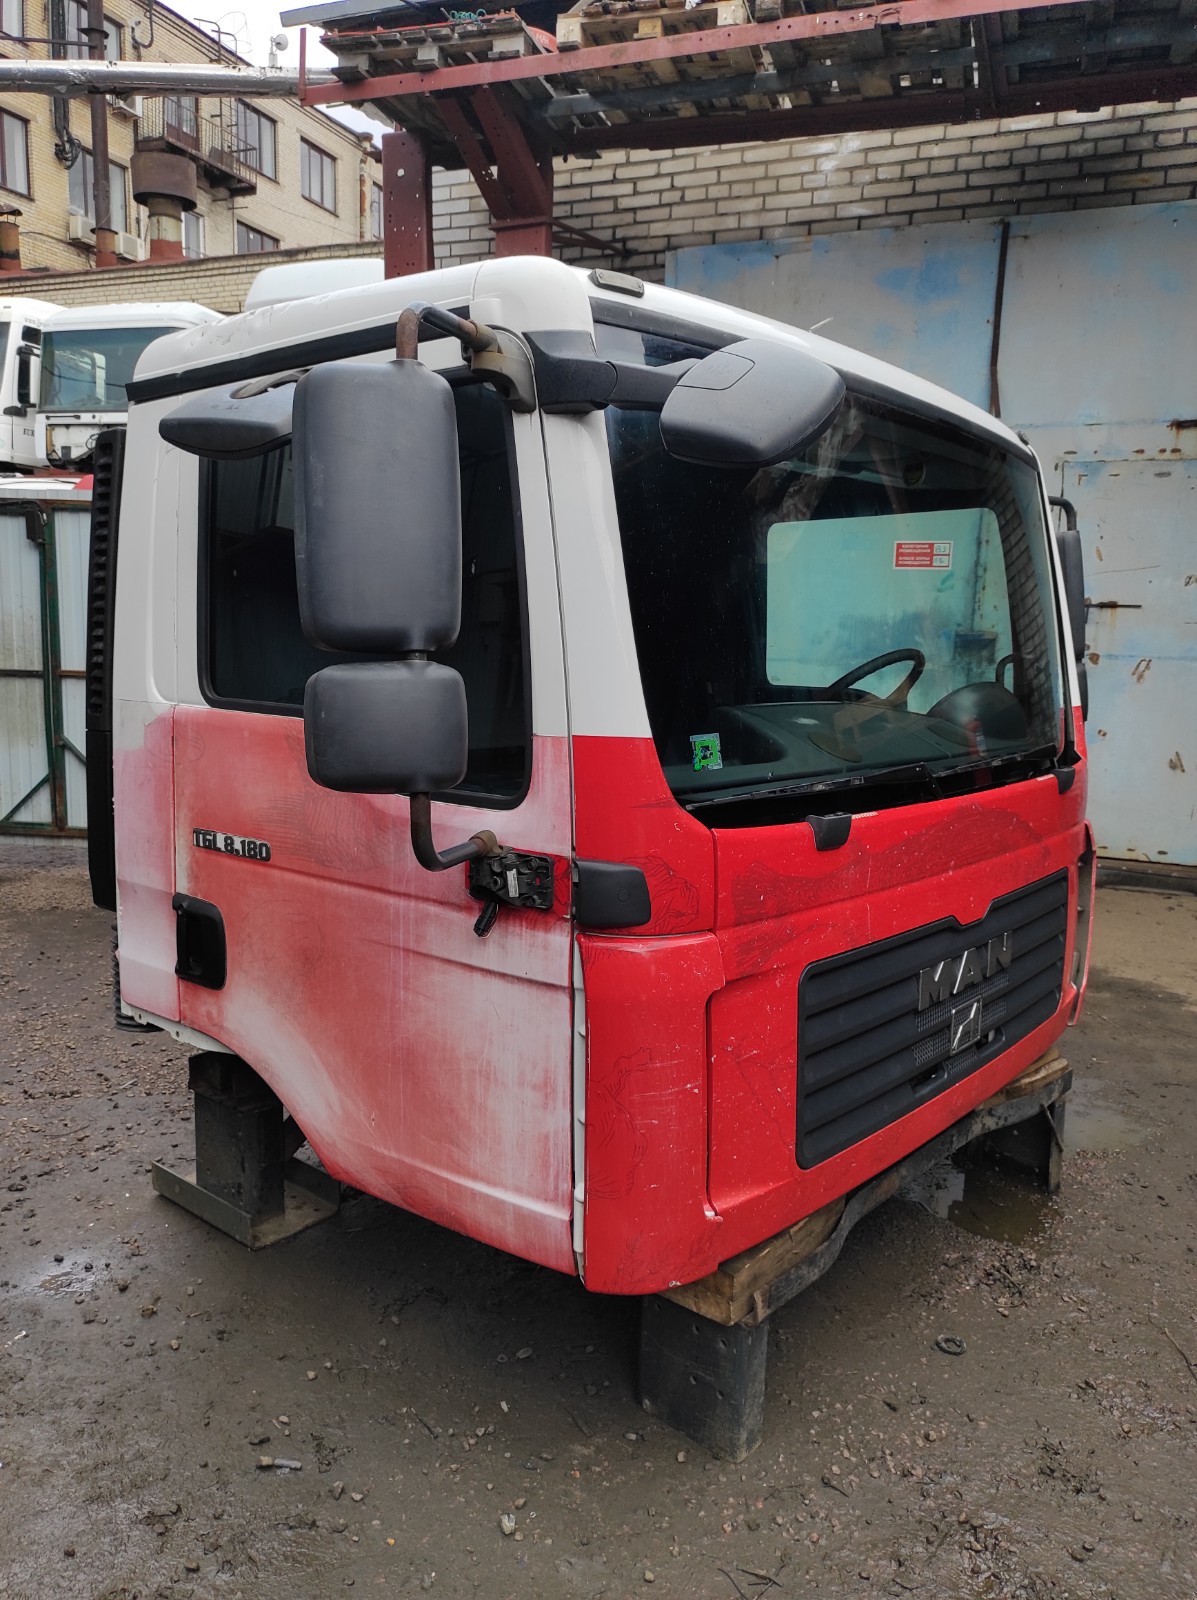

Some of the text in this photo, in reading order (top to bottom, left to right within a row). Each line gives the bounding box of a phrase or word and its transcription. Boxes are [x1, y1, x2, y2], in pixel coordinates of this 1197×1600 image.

[193, 828, 271, 862] TGL 8.180
[918, 929, 1013, 1012] MAN
